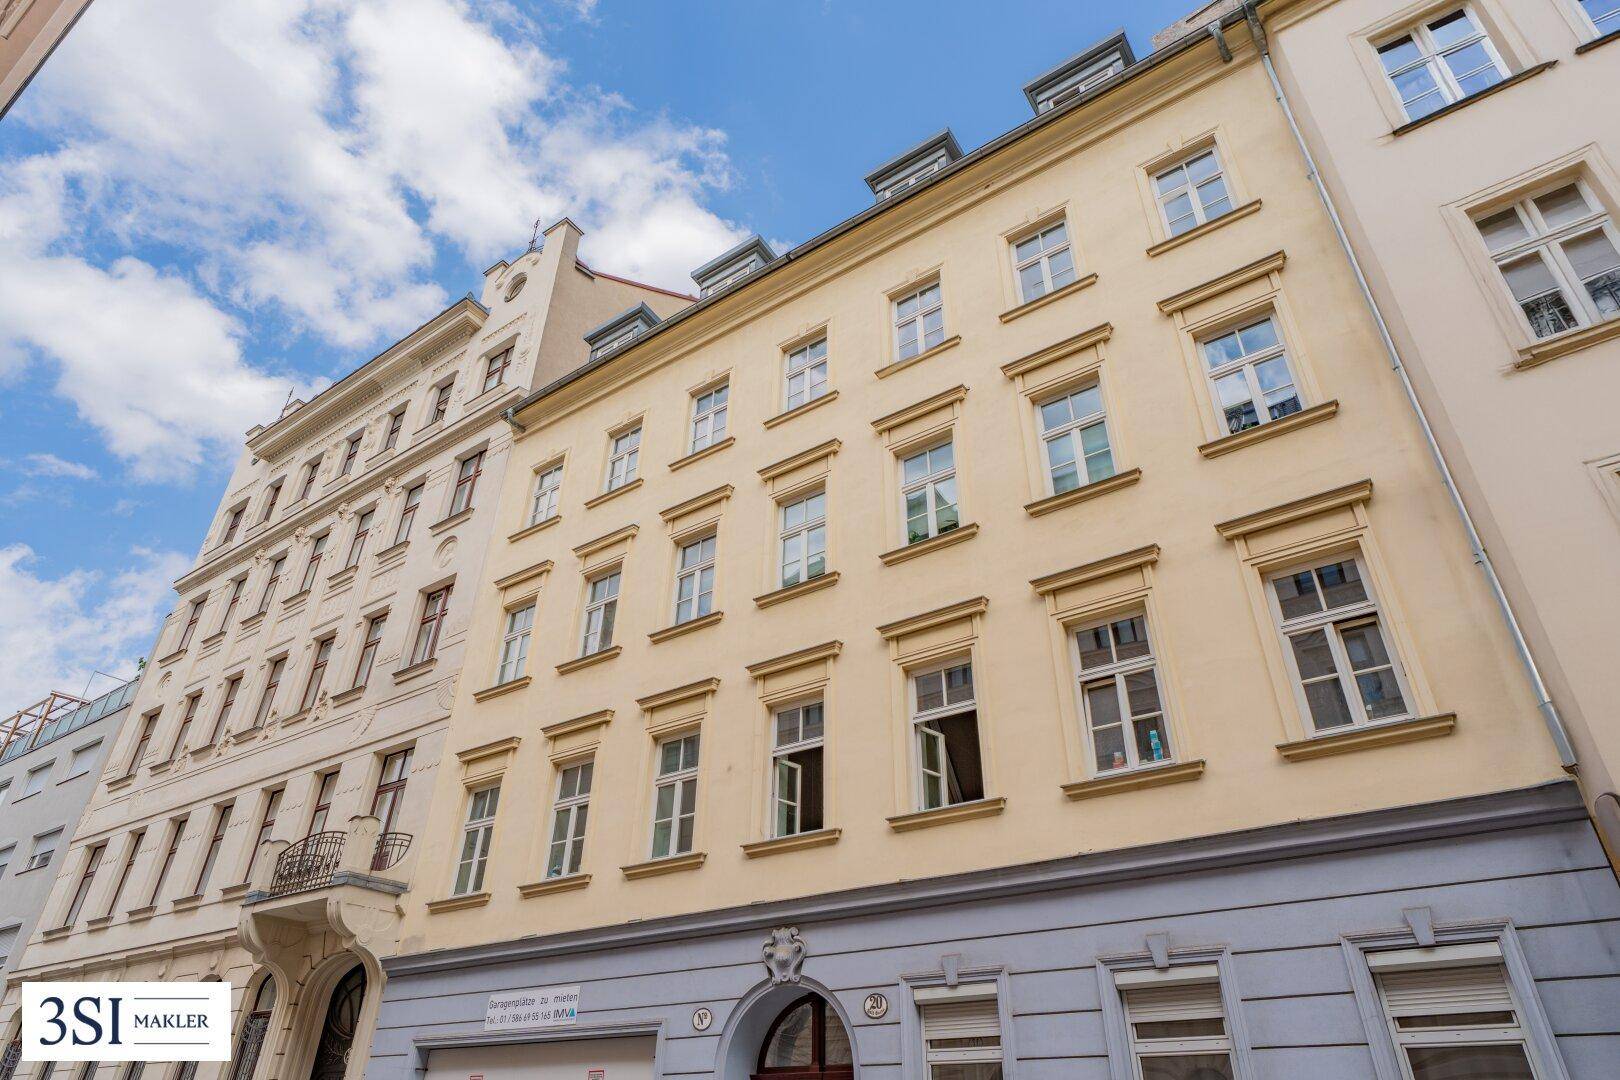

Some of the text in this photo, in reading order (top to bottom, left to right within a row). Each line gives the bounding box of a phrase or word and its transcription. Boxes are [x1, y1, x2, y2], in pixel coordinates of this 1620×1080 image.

[489, 994, 578, 1010] Garagenplätze zu mieten
[869, 995, 883, 1010] 20
[500, 1015, 507, 1024] 01
[511, 1013, 522, 1023] 586
[532, 1012, 539, 1021] 55
[540, 1011, 552, 1020] 165
